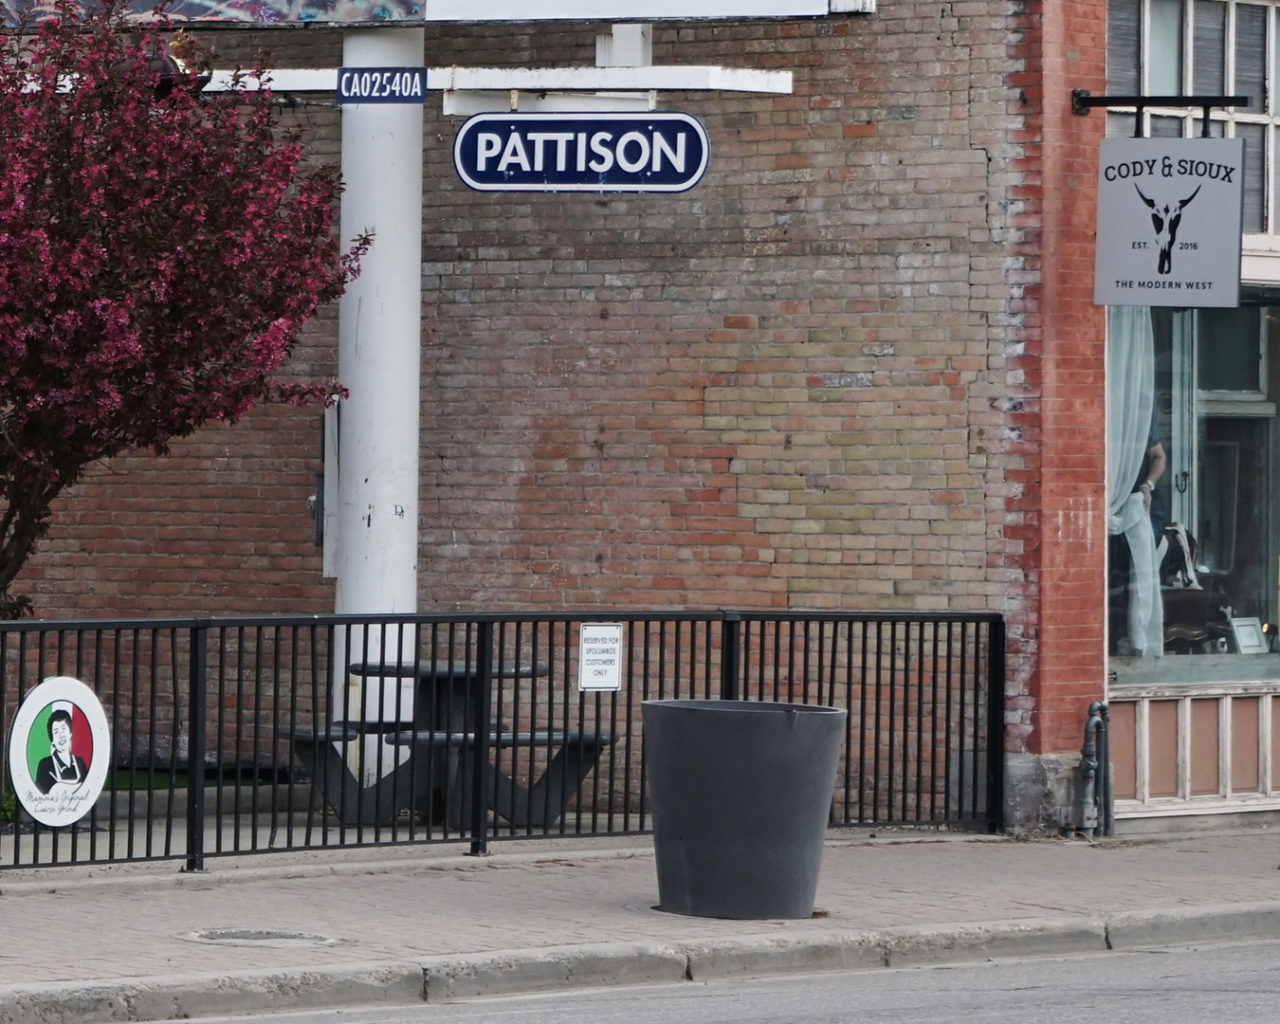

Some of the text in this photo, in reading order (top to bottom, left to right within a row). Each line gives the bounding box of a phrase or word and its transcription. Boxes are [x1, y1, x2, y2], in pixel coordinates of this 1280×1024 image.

[340, 71, 422, 98] CA02540A
[476, 130, 687, 174] PATTISON
[1104, 156, 1236, 184] CODY & SIOUX
[1132, 241, 1198, 250] EST. 2016
[1115, 280, 1213, 290] THE MODERN WEST
